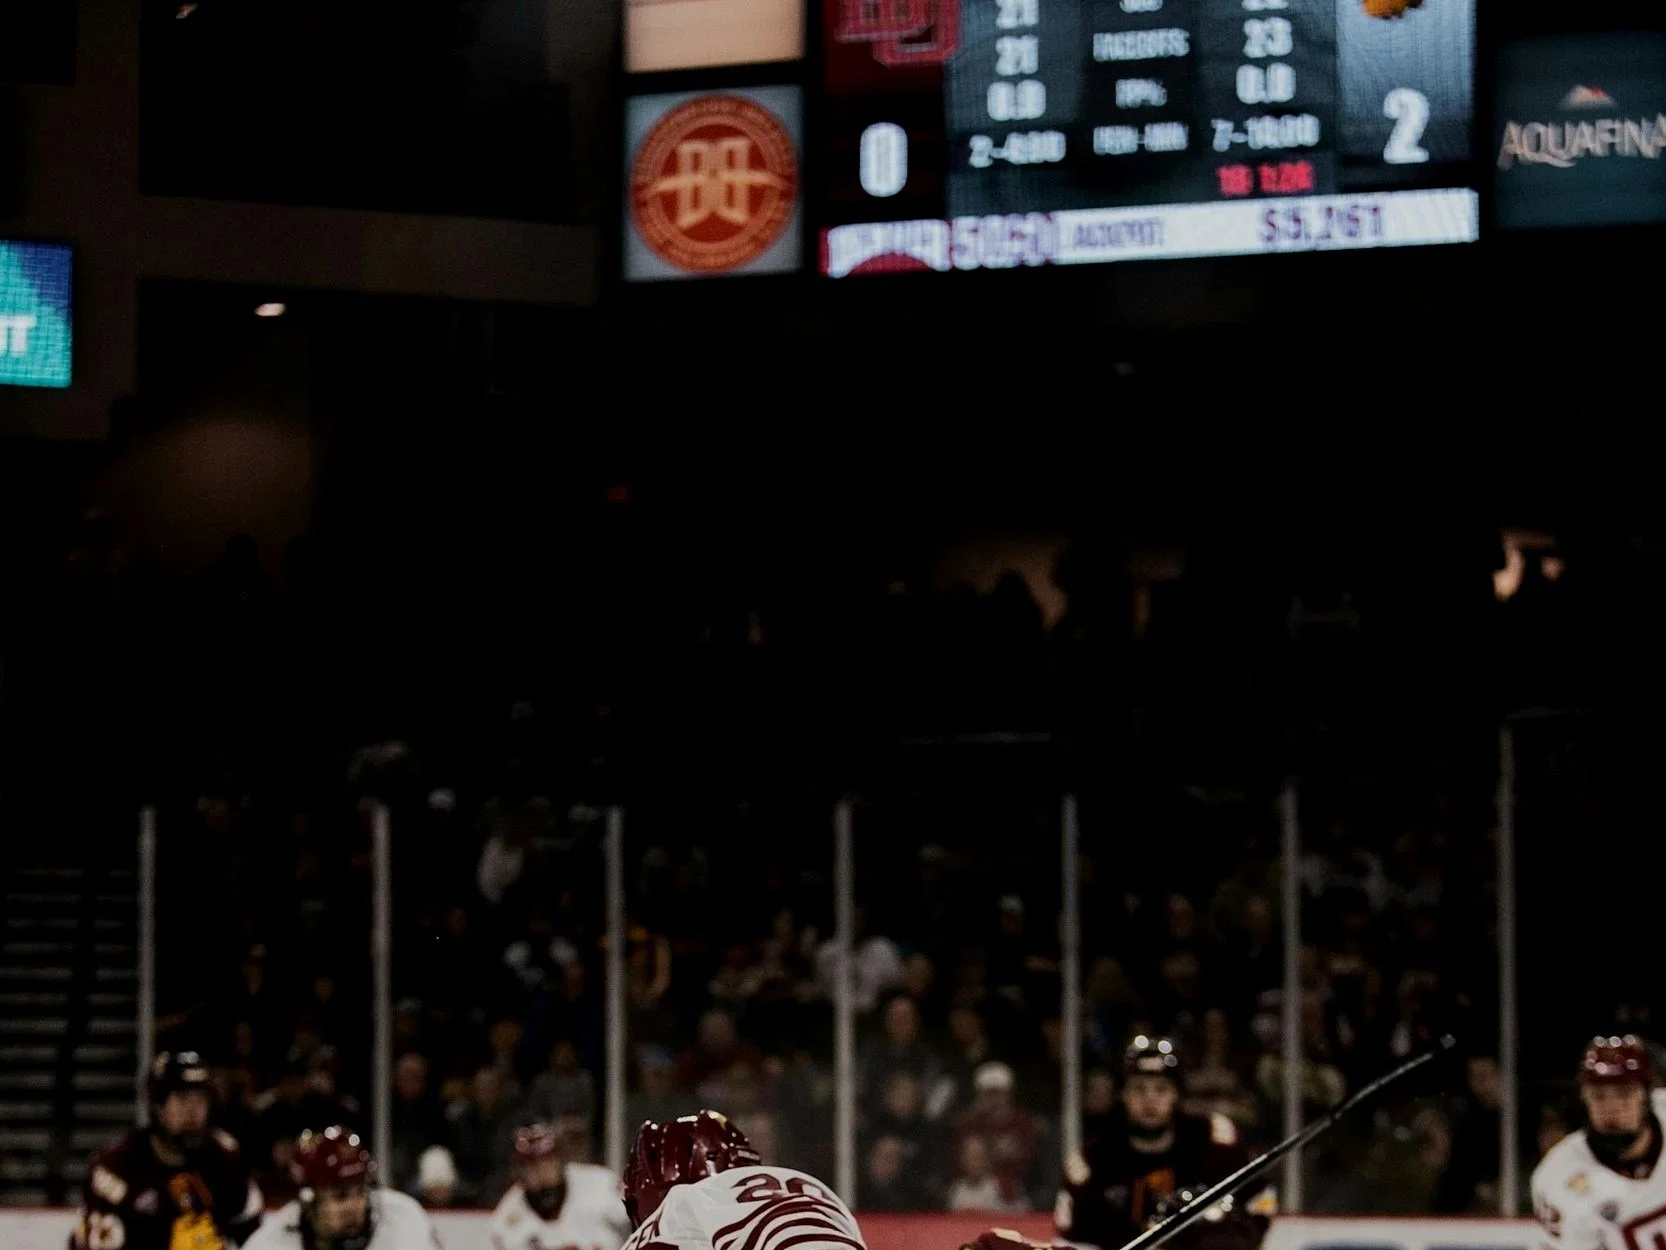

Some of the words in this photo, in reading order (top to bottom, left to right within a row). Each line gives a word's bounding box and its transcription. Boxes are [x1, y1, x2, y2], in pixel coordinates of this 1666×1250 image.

[859, 121, 908, 197] 0
[1383, 87, 1430, 164] 2
[1498, 112, 1666, 170] AQUAFINA
